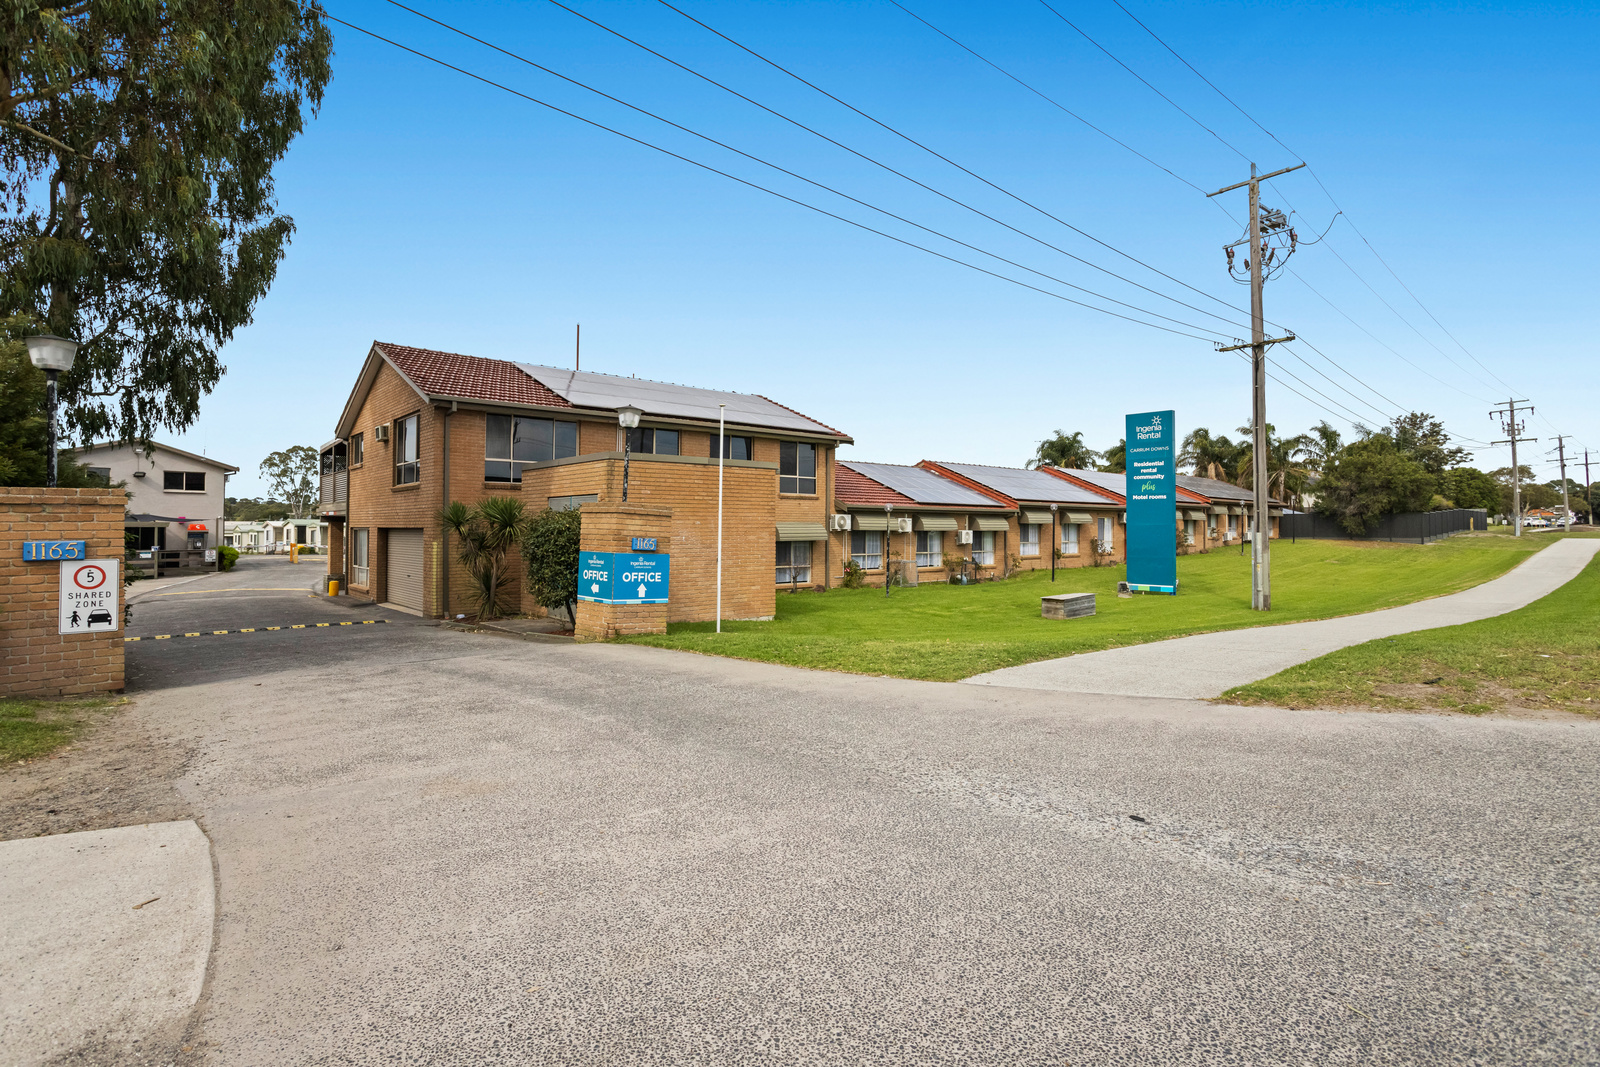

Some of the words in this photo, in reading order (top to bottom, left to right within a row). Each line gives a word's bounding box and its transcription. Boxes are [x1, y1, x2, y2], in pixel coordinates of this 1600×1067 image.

[1136, 424, 1162, 433] Ingenia
[1142, 481, 1156, 492] plus
[637, 538, 655, 550] 1165
[32, 542, 78, 560] 1165
[87, 572, 94, 583] 5
[583, 570, 608, 582] OFFICE
[622, 572, 662, 582] OFFICE
[68, 591, 111, 600] SHARED
[75, 600, 104, 608] ZONE
